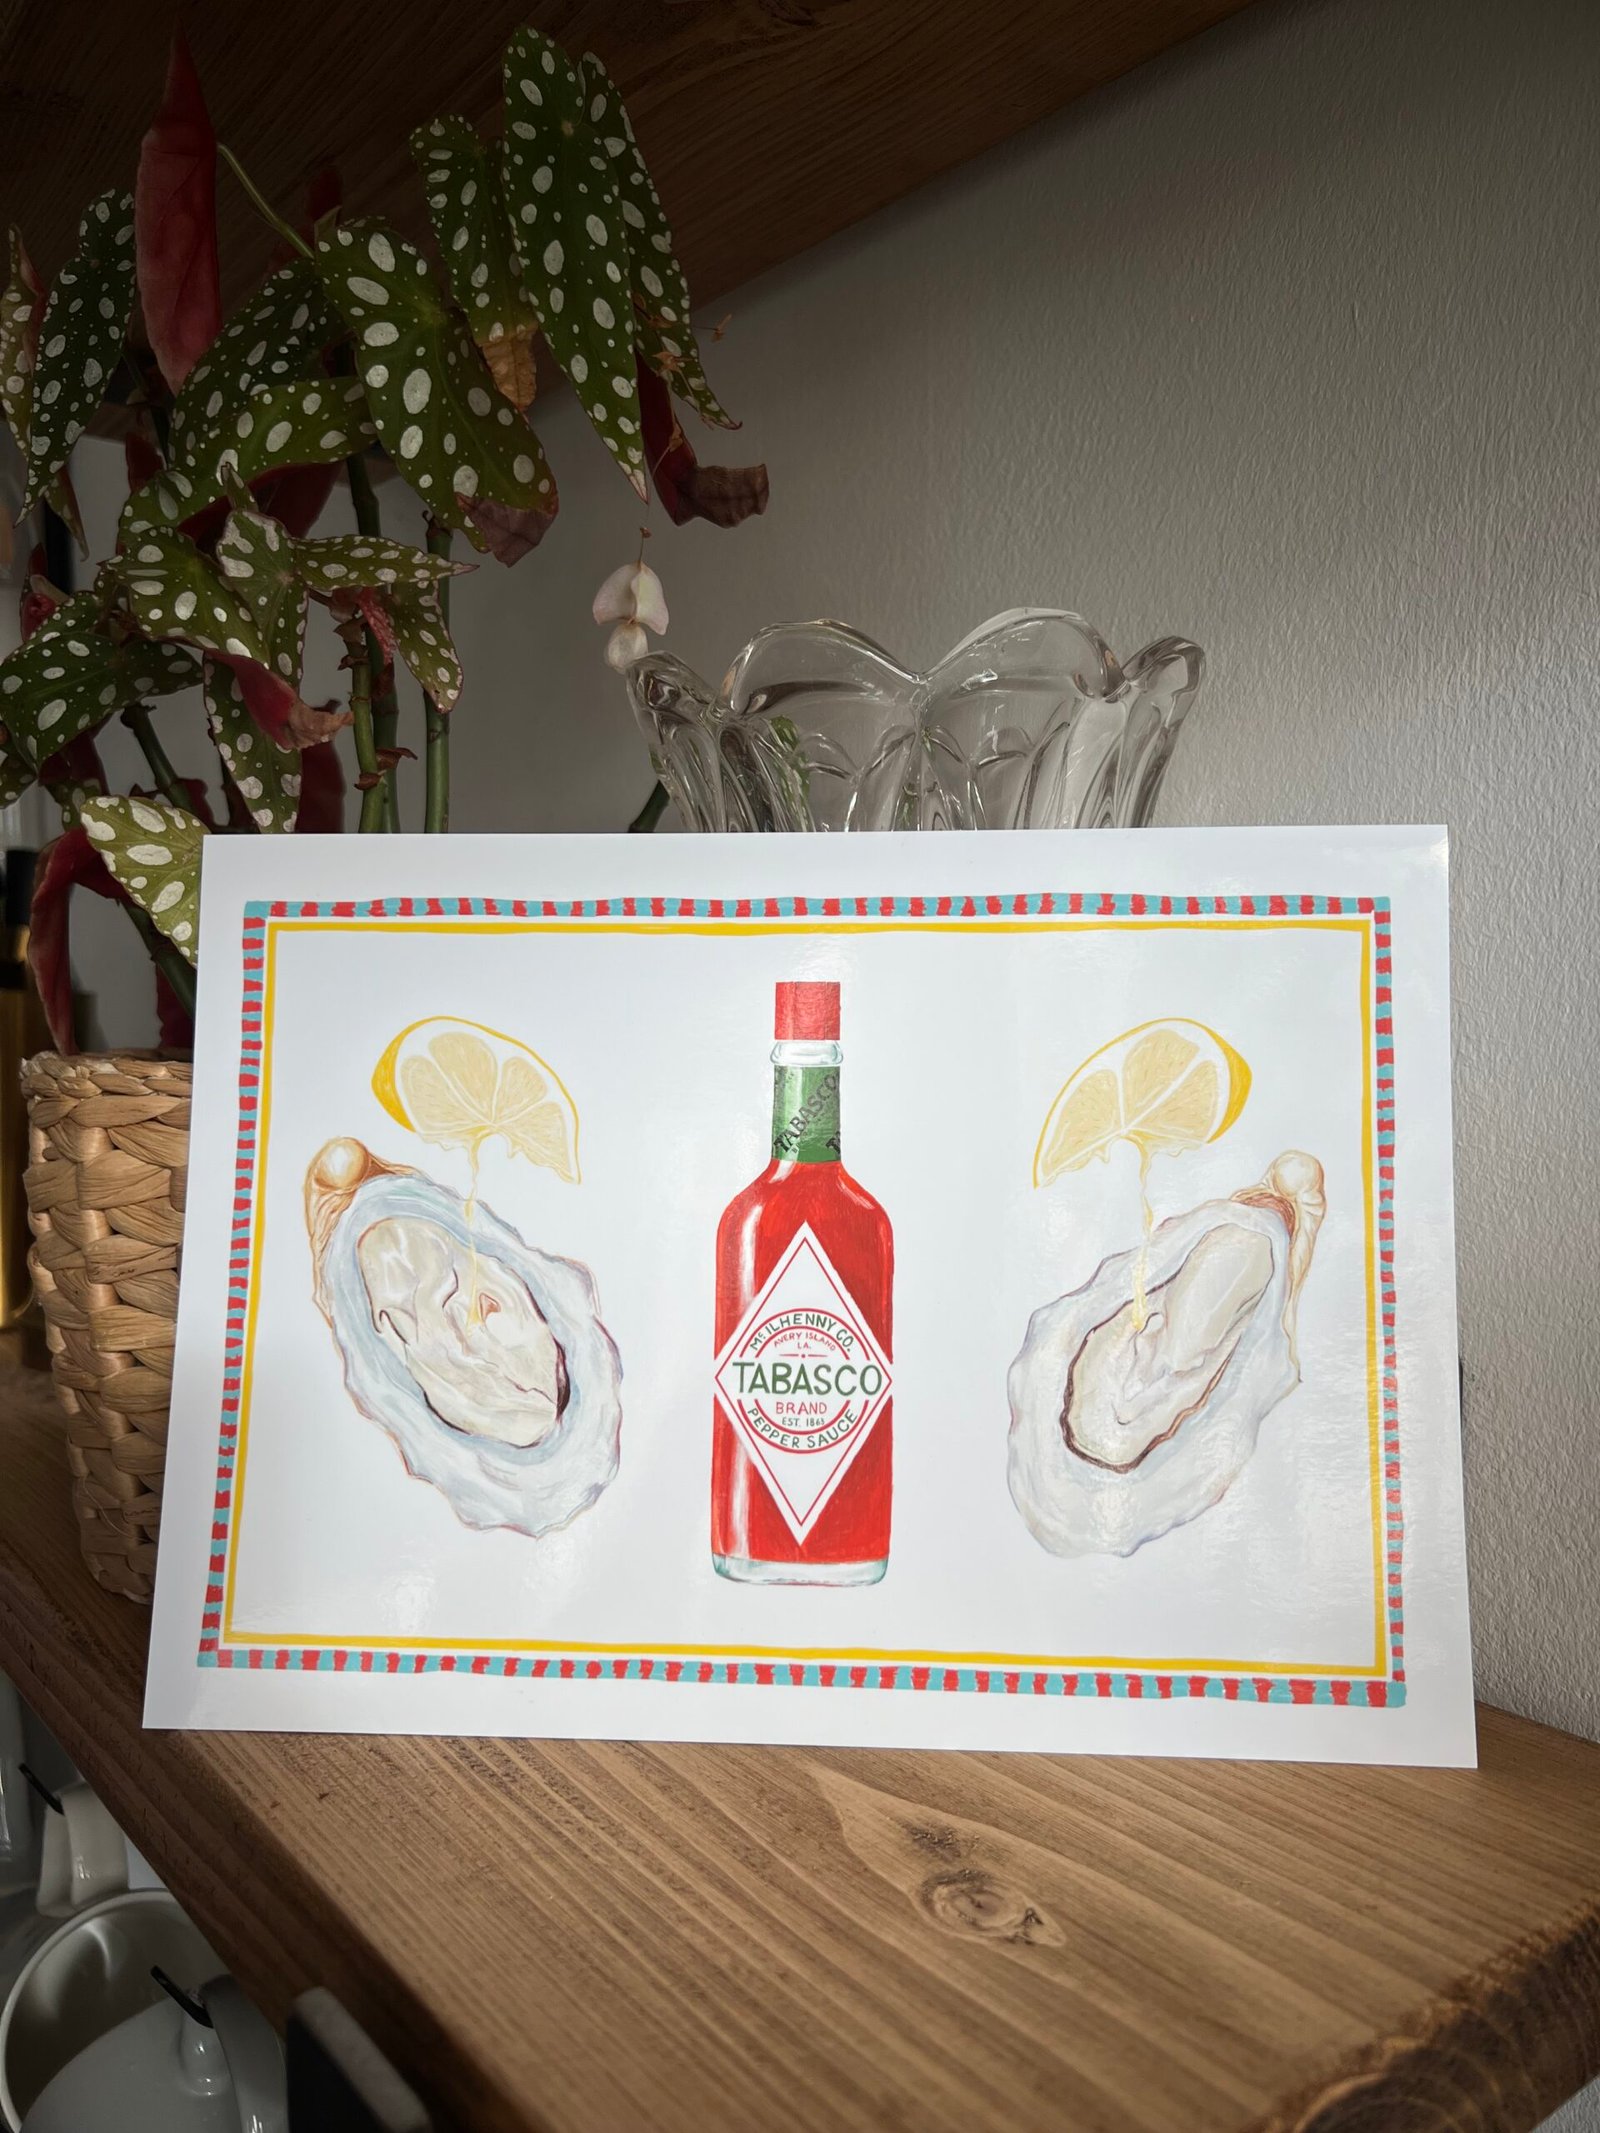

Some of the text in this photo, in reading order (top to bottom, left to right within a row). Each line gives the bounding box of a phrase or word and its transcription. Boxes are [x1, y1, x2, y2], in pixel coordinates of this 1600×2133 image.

[773, 1074, 836, 1152] TABASCO
[773, 1332, 836, 1351] AVERY ISLAND
[732, 1362, 882, 1396] TABASCO
[775, 1401, 827, 1415] BRAND
[747, 1407, 858, 1448] PEPPER SAUCE
